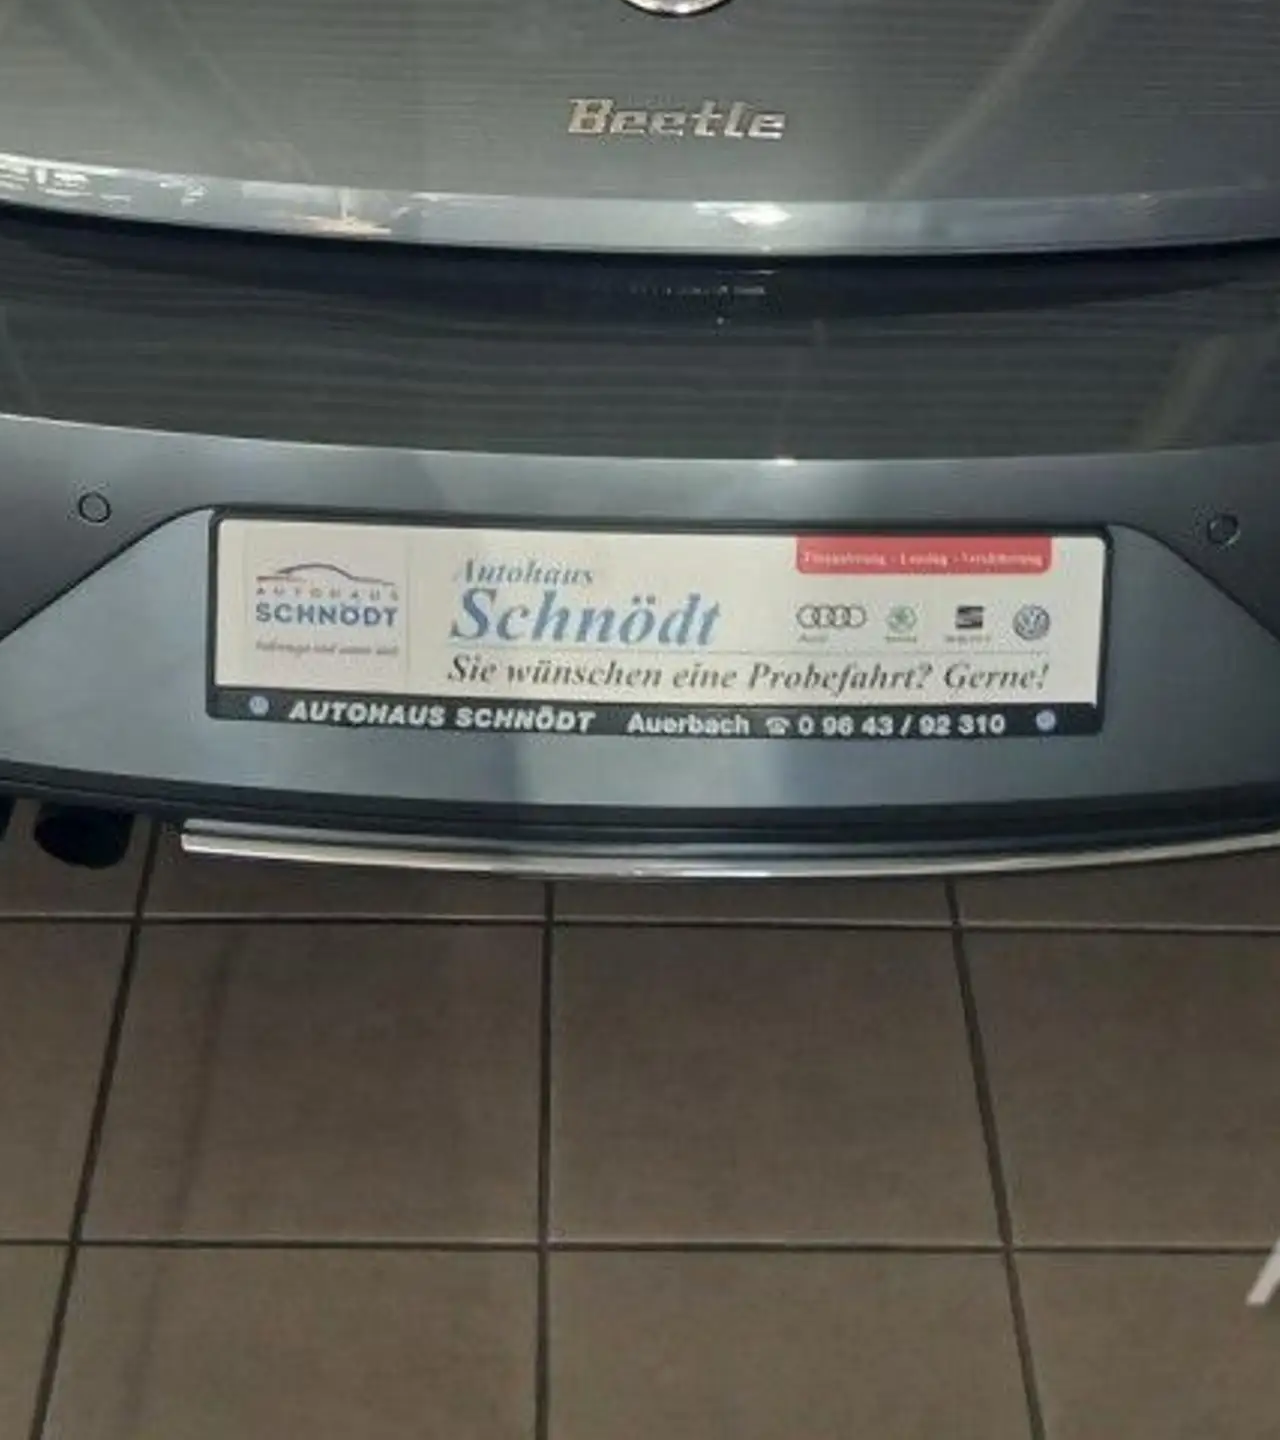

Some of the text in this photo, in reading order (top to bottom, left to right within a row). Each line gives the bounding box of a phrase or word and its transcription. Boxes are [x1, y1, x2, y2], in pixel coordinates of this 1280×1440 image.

[567, 97, 787, 140] Beetle
[455, 558, 595, 585] Autohaus
[256, 601, 399, 627] SCHNÖDT
[448, 587, 722, 646] Schnödt
[447, 654, 1050, 698] Sie wünschen eine Probefahrt? Gerne!
[289, 700, 446, 728] AUTOHAUS
[454, 705, 596, 734] SCHNÖDT
[627, 712, 751, 736] Auerbach
[958, 714, 1007, 736] 310
